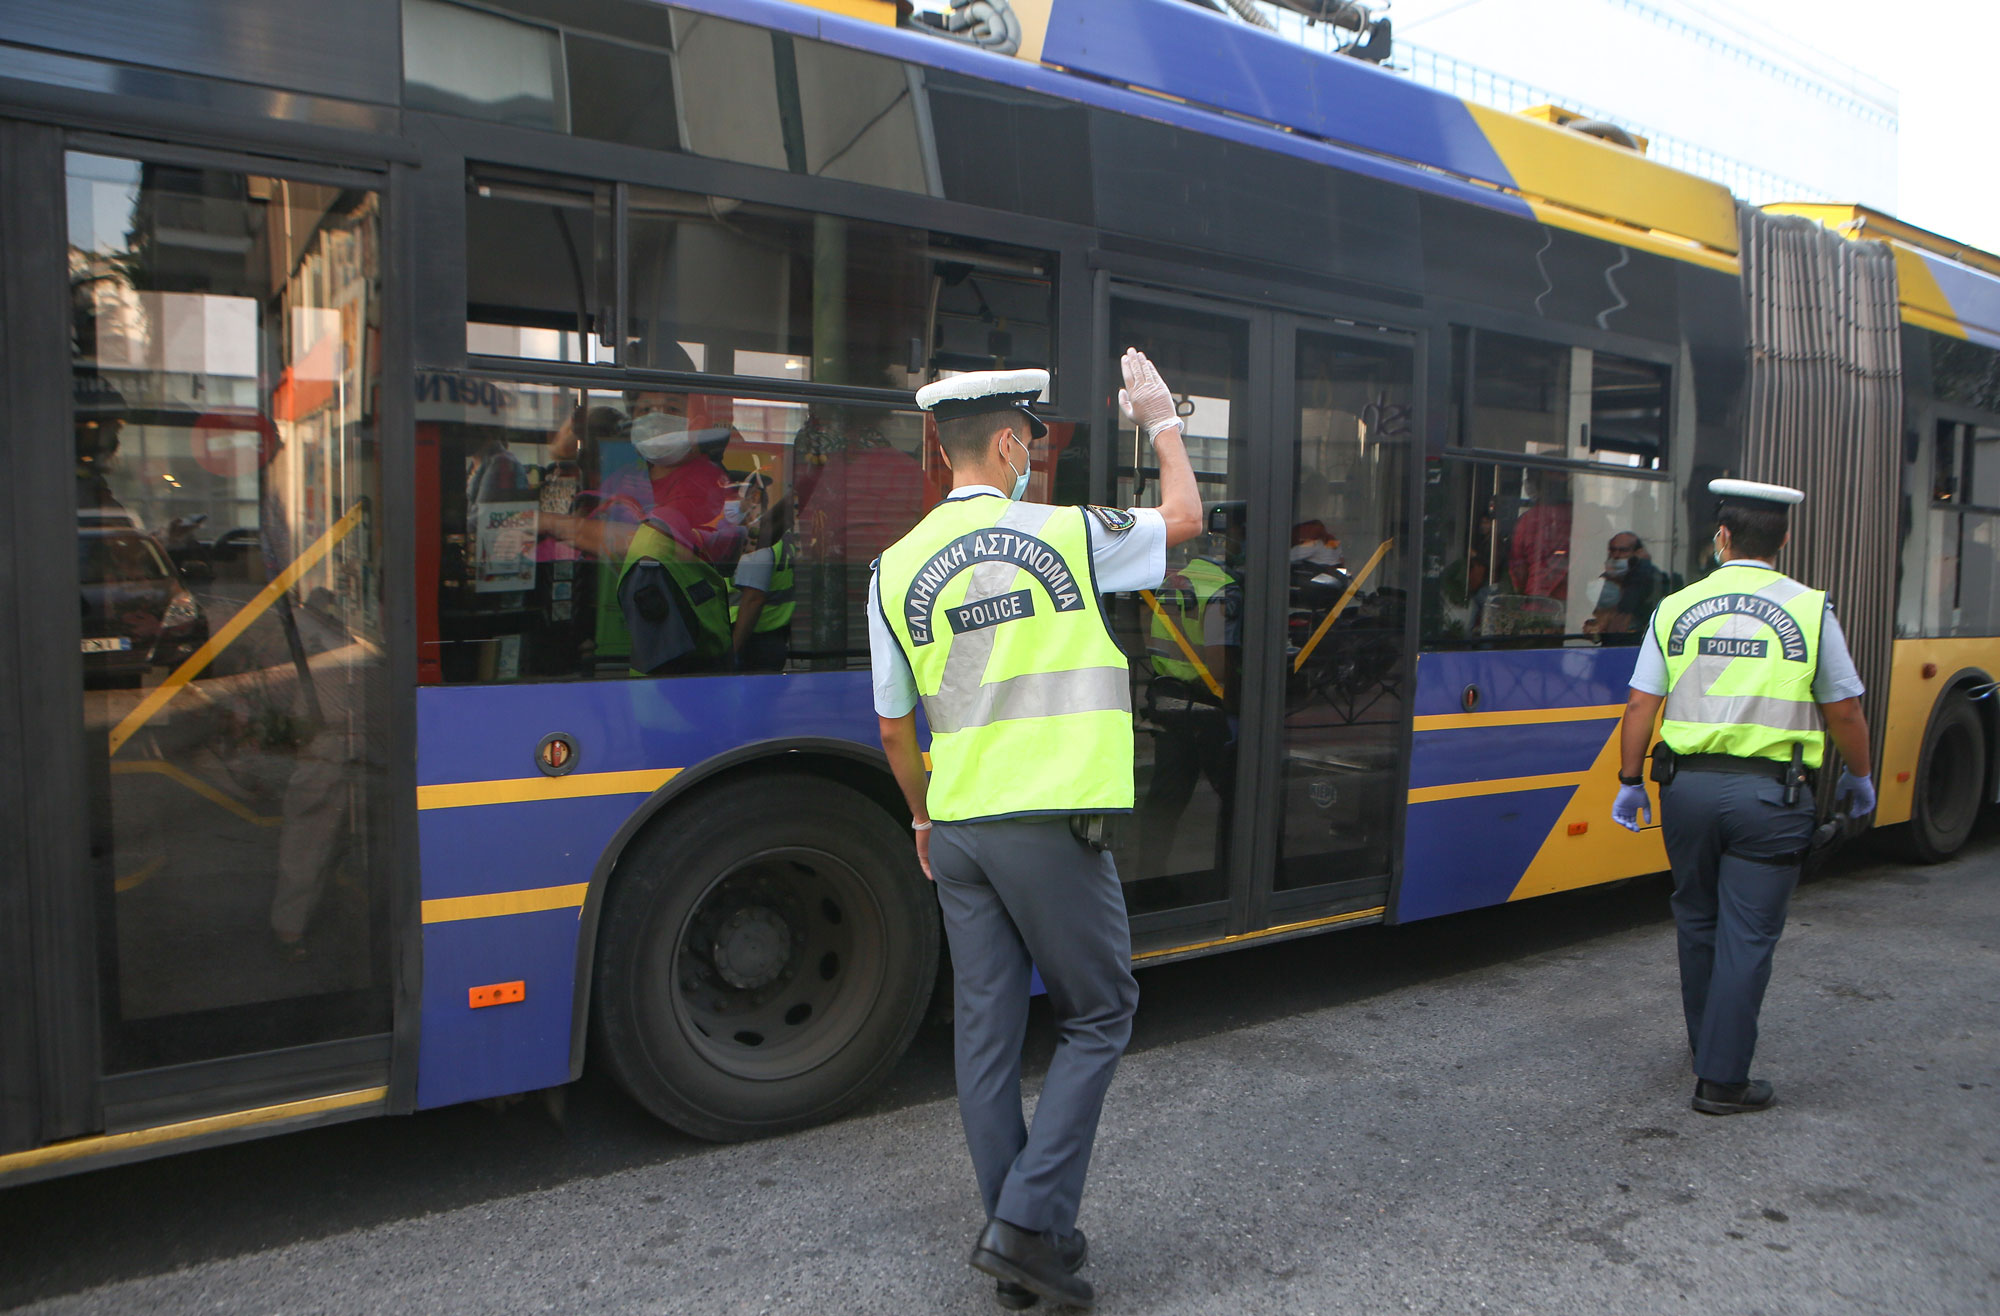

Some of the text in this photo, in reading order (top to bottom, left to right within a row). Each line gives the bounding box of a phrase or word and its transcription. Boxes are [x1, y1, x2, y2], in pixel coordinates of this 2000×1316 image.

[909, 533, 1078, 642] ΕΛΛΗΝΙΚΗ ΑΣΤΥΝΟΜΙΑ
[959, 595, 1022, 628] POLICE
[1671, 596, 1804, 660] ΕΛΛΗΝΙΚΗ ΑΣΤΥΝΟΜΙΑ
[1707, 640, 1760, 655] POLICE
